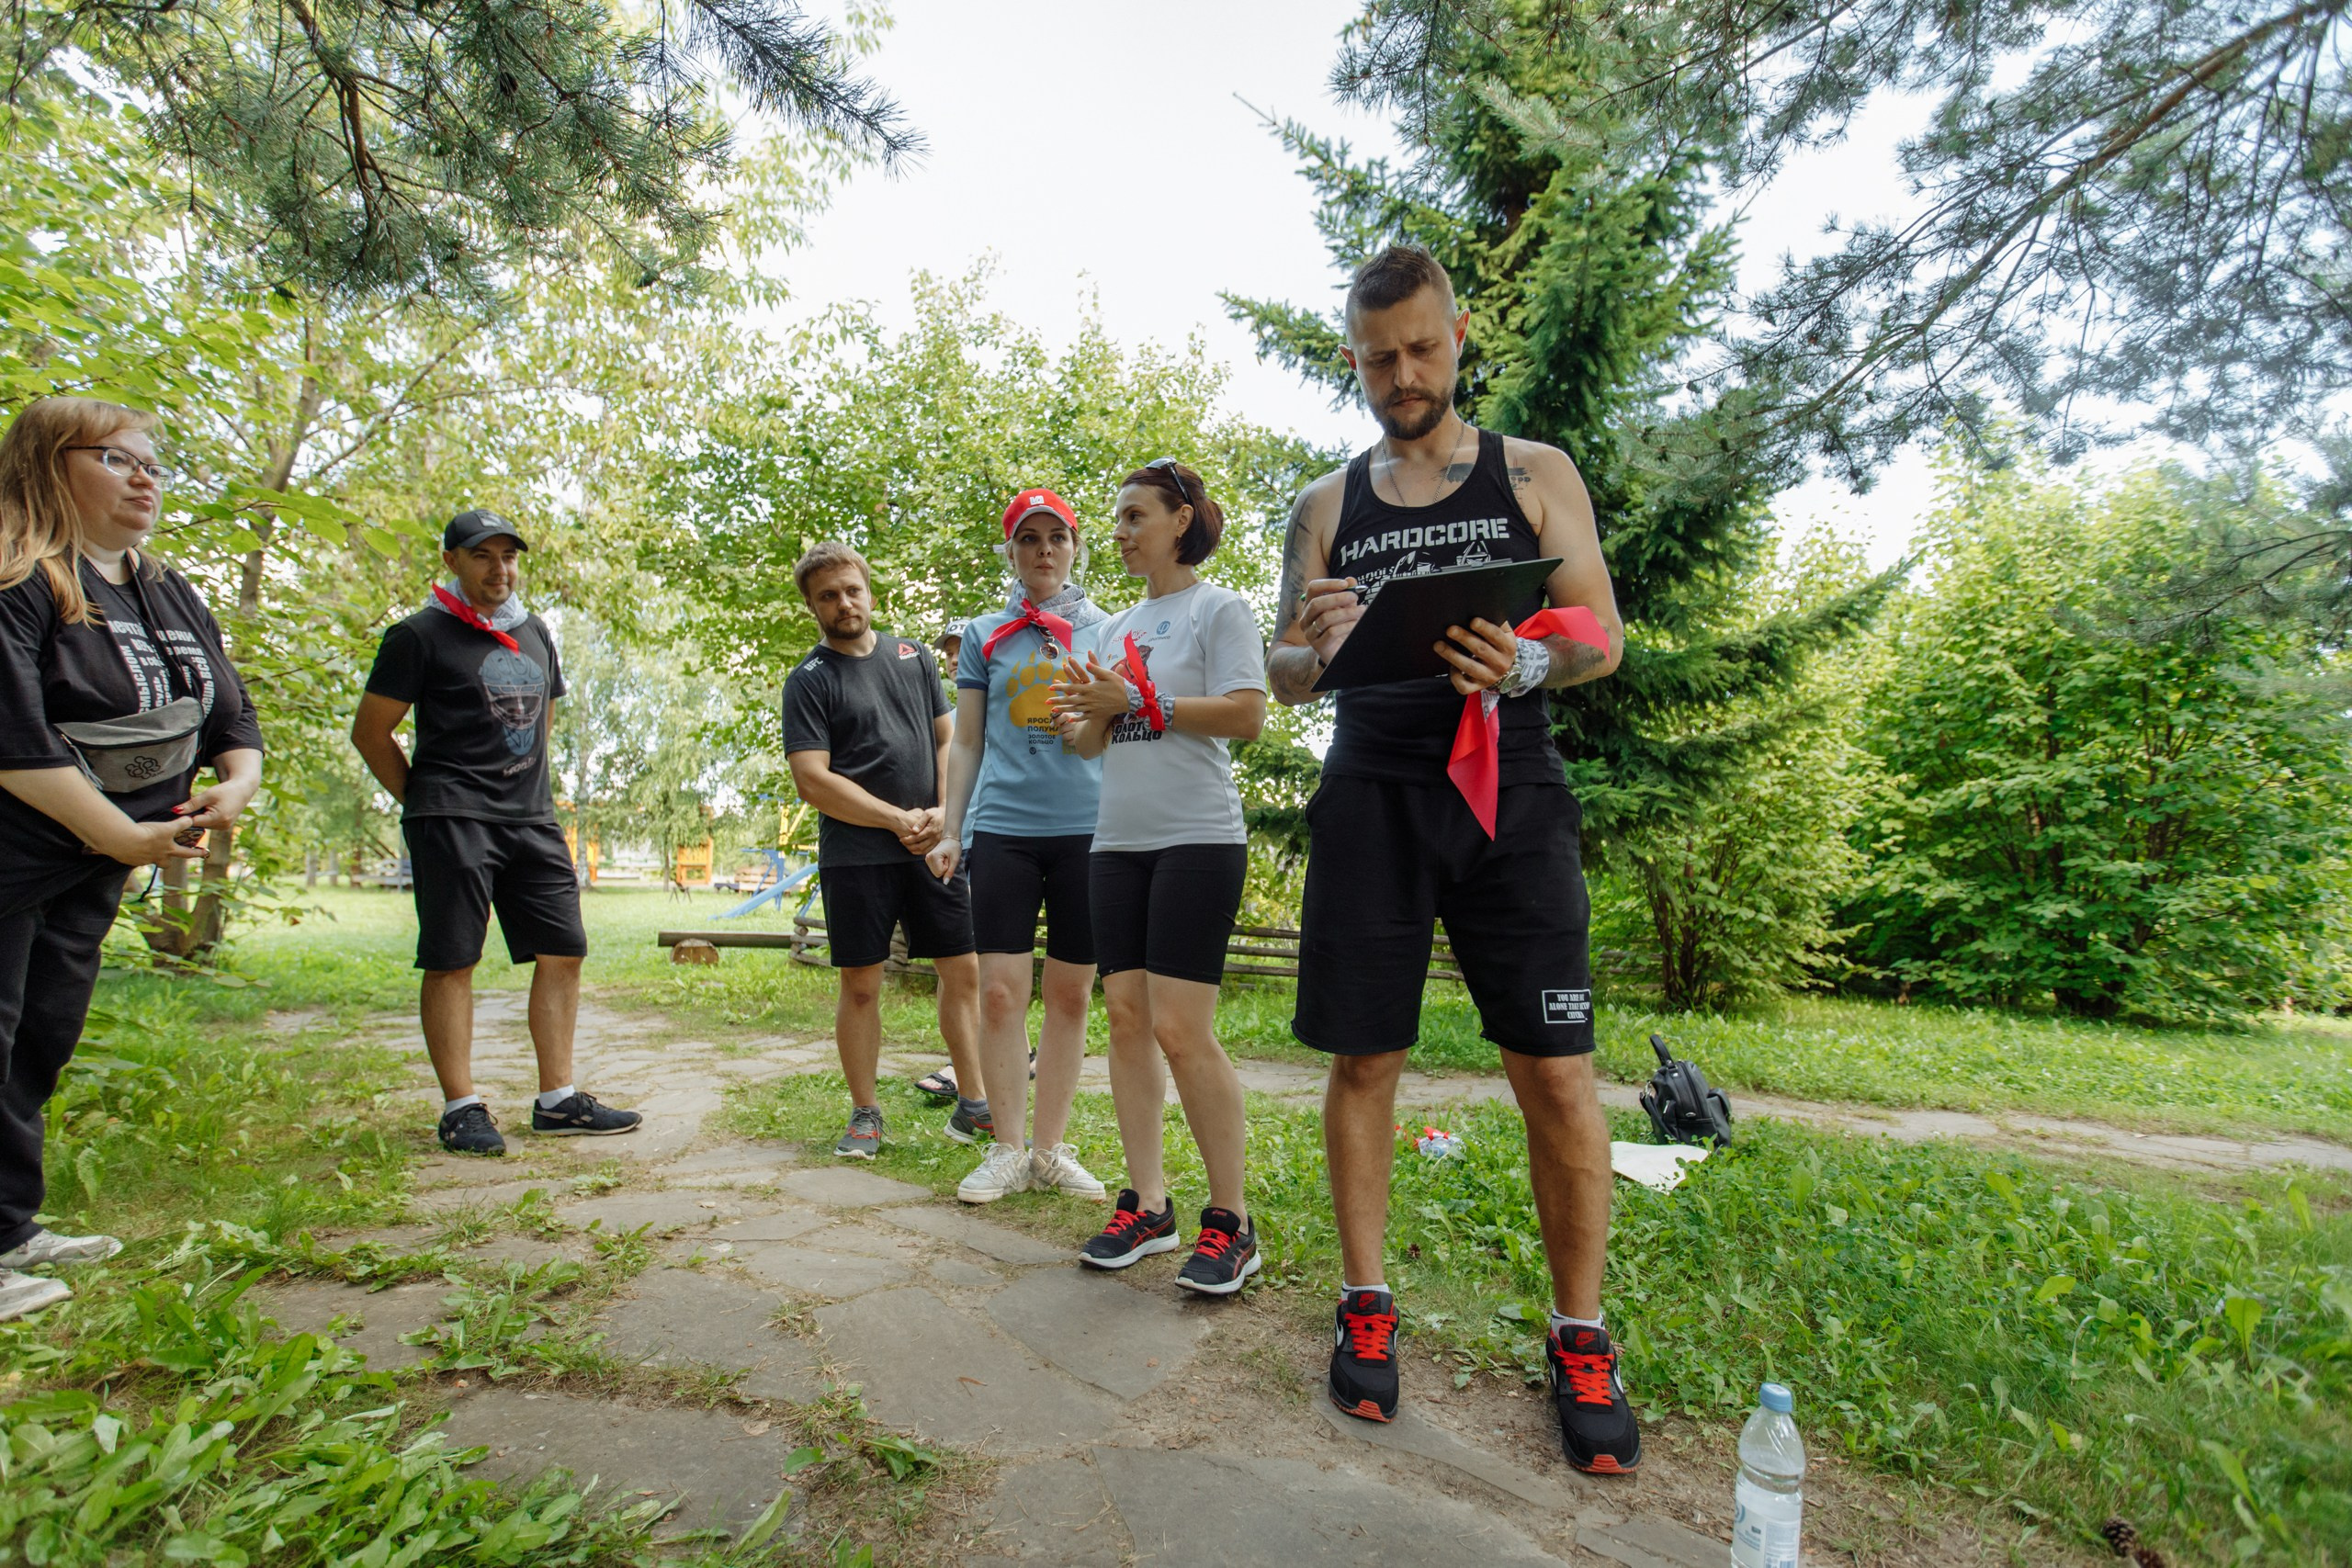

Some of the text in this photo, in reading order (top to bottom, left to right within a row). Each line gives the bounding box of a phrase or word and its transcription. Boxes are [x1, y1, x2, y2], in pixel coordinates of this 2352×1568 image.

[1340, 517, 1510, 567] HARDCORE
[803, 656, 824, 671] UFC
[1111, 731, 1163, 745] КОЛЬЦО
